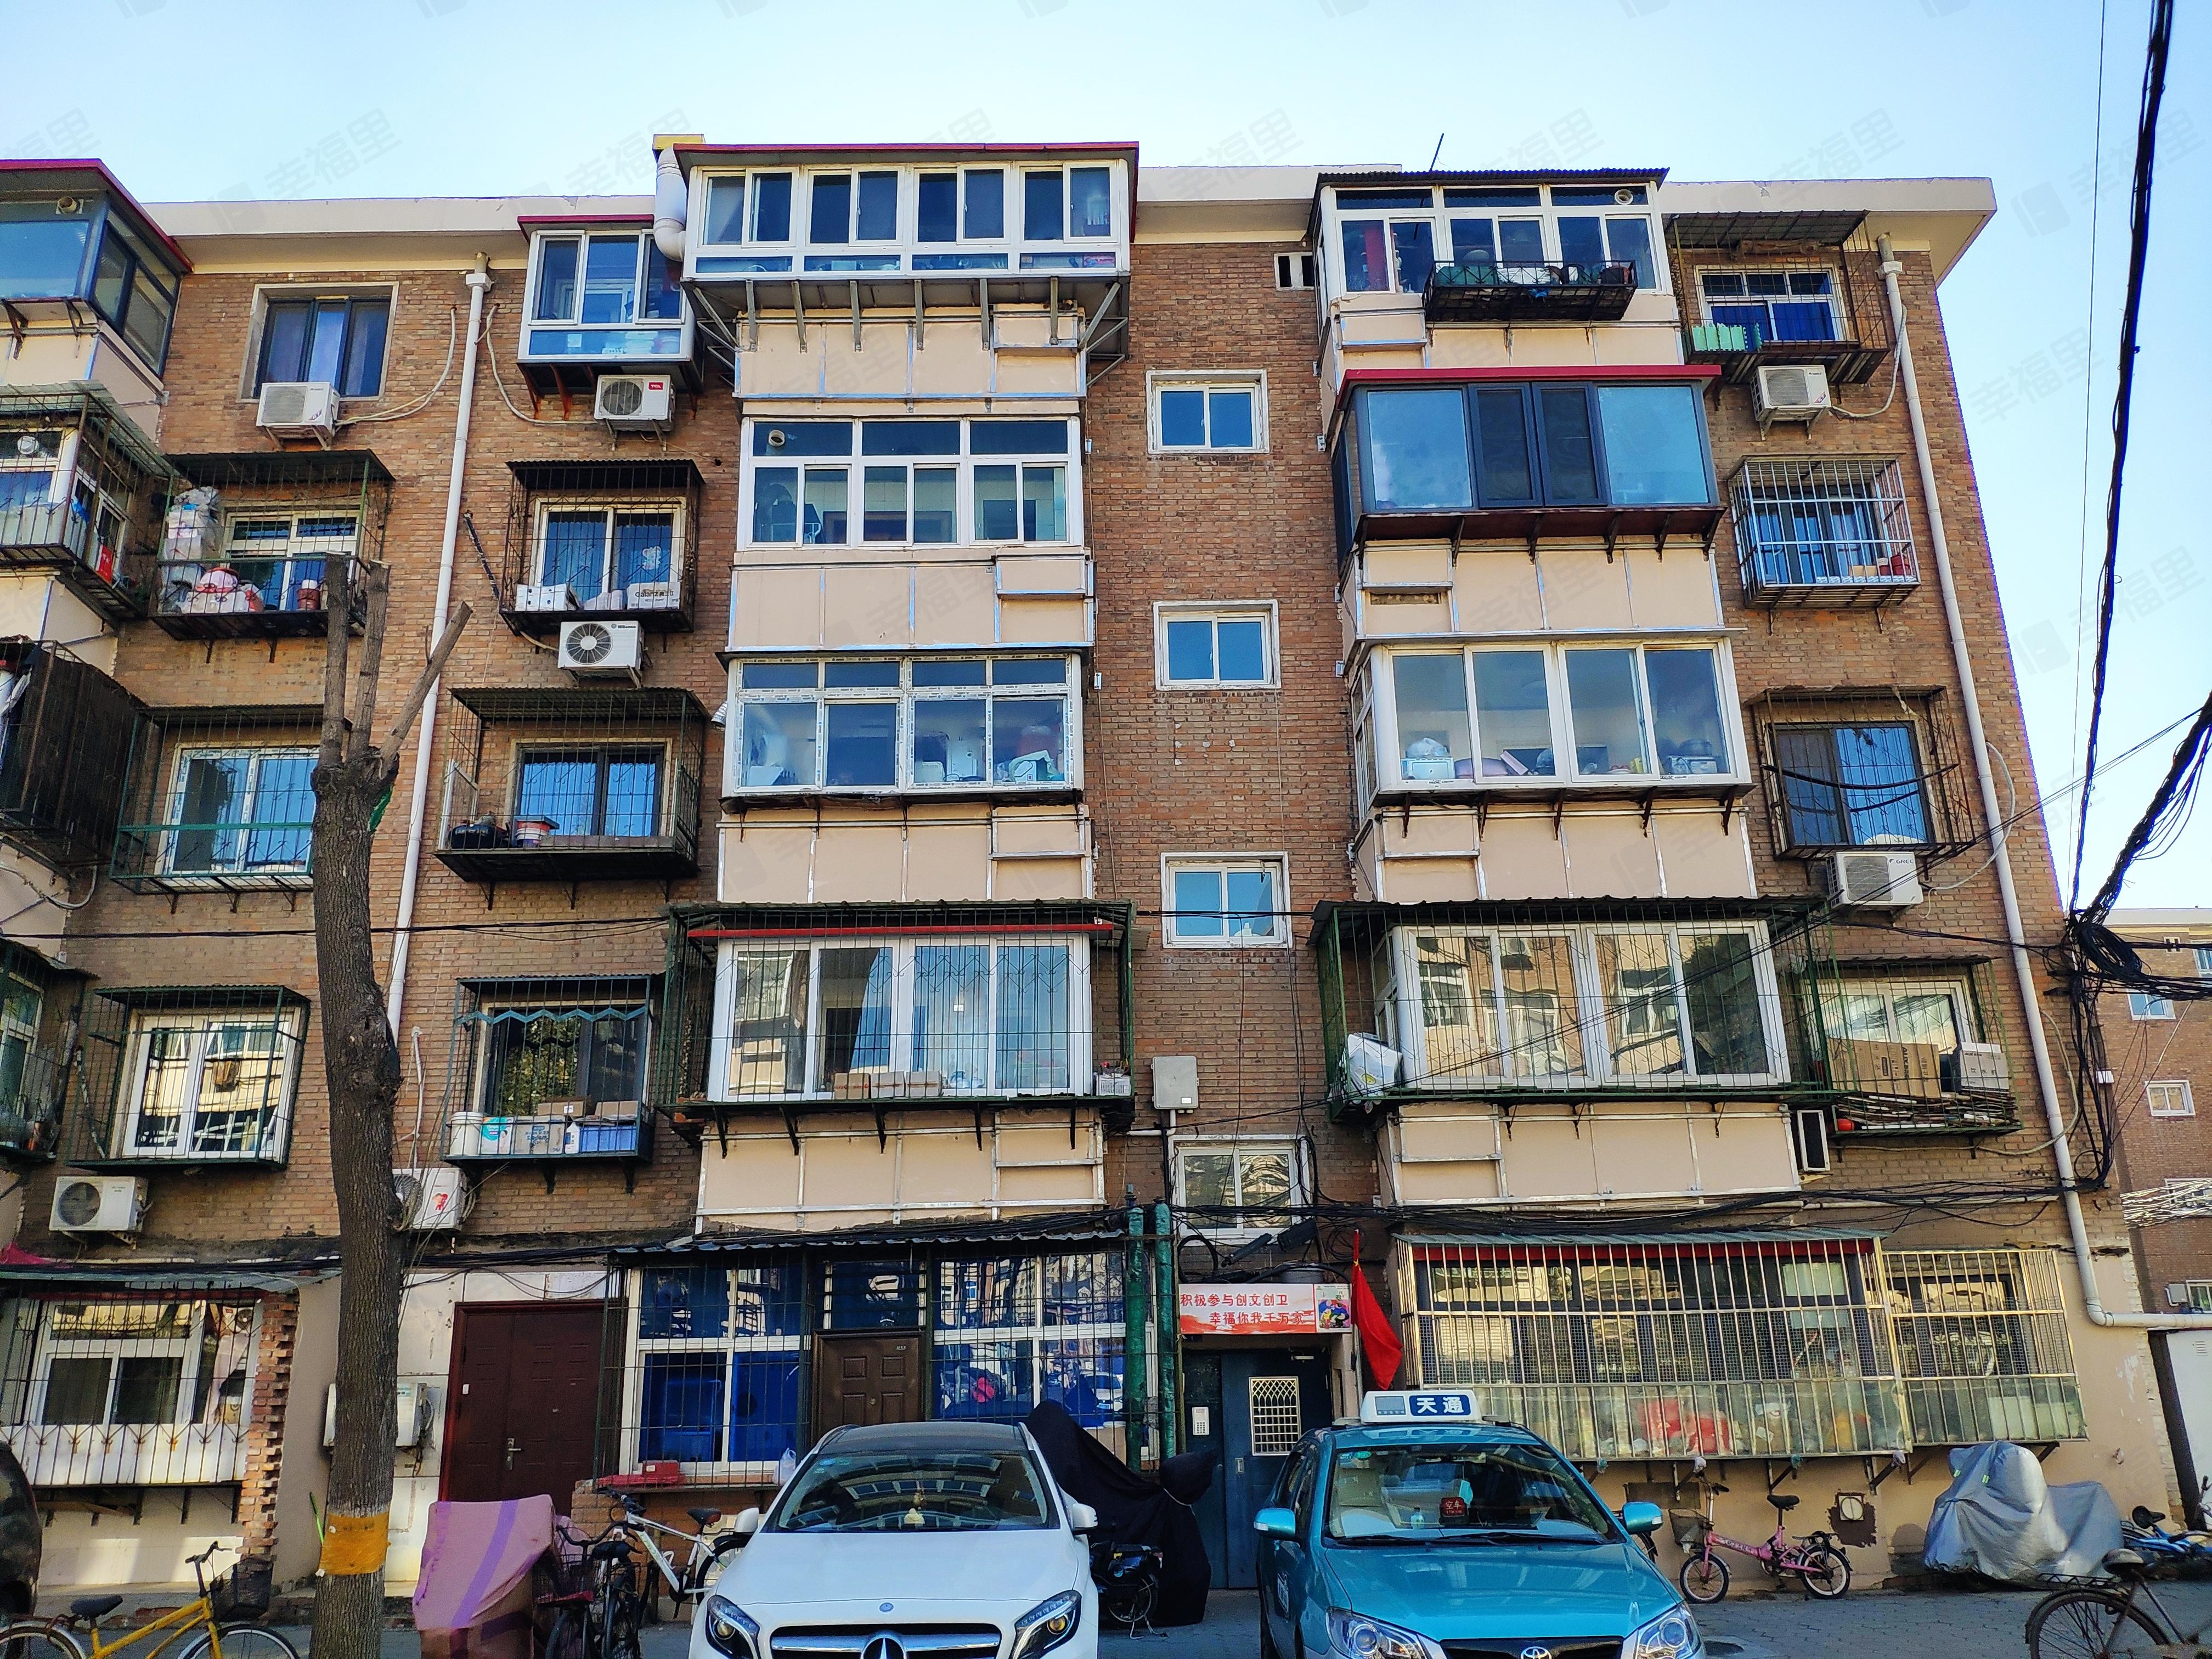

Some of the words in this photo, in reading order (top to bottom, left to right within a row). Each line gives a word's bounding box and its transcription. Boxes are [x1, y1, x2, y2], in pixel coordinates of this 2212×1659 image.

[1180, 1293, 1289, 1307] 积极参与创文创卫
[1210, 1311, 1305, 1325] 幸福你我千万家
[1416, 1396, 1464, 1414] 天通
[1444, 1500, 1462, 1510] 空车
